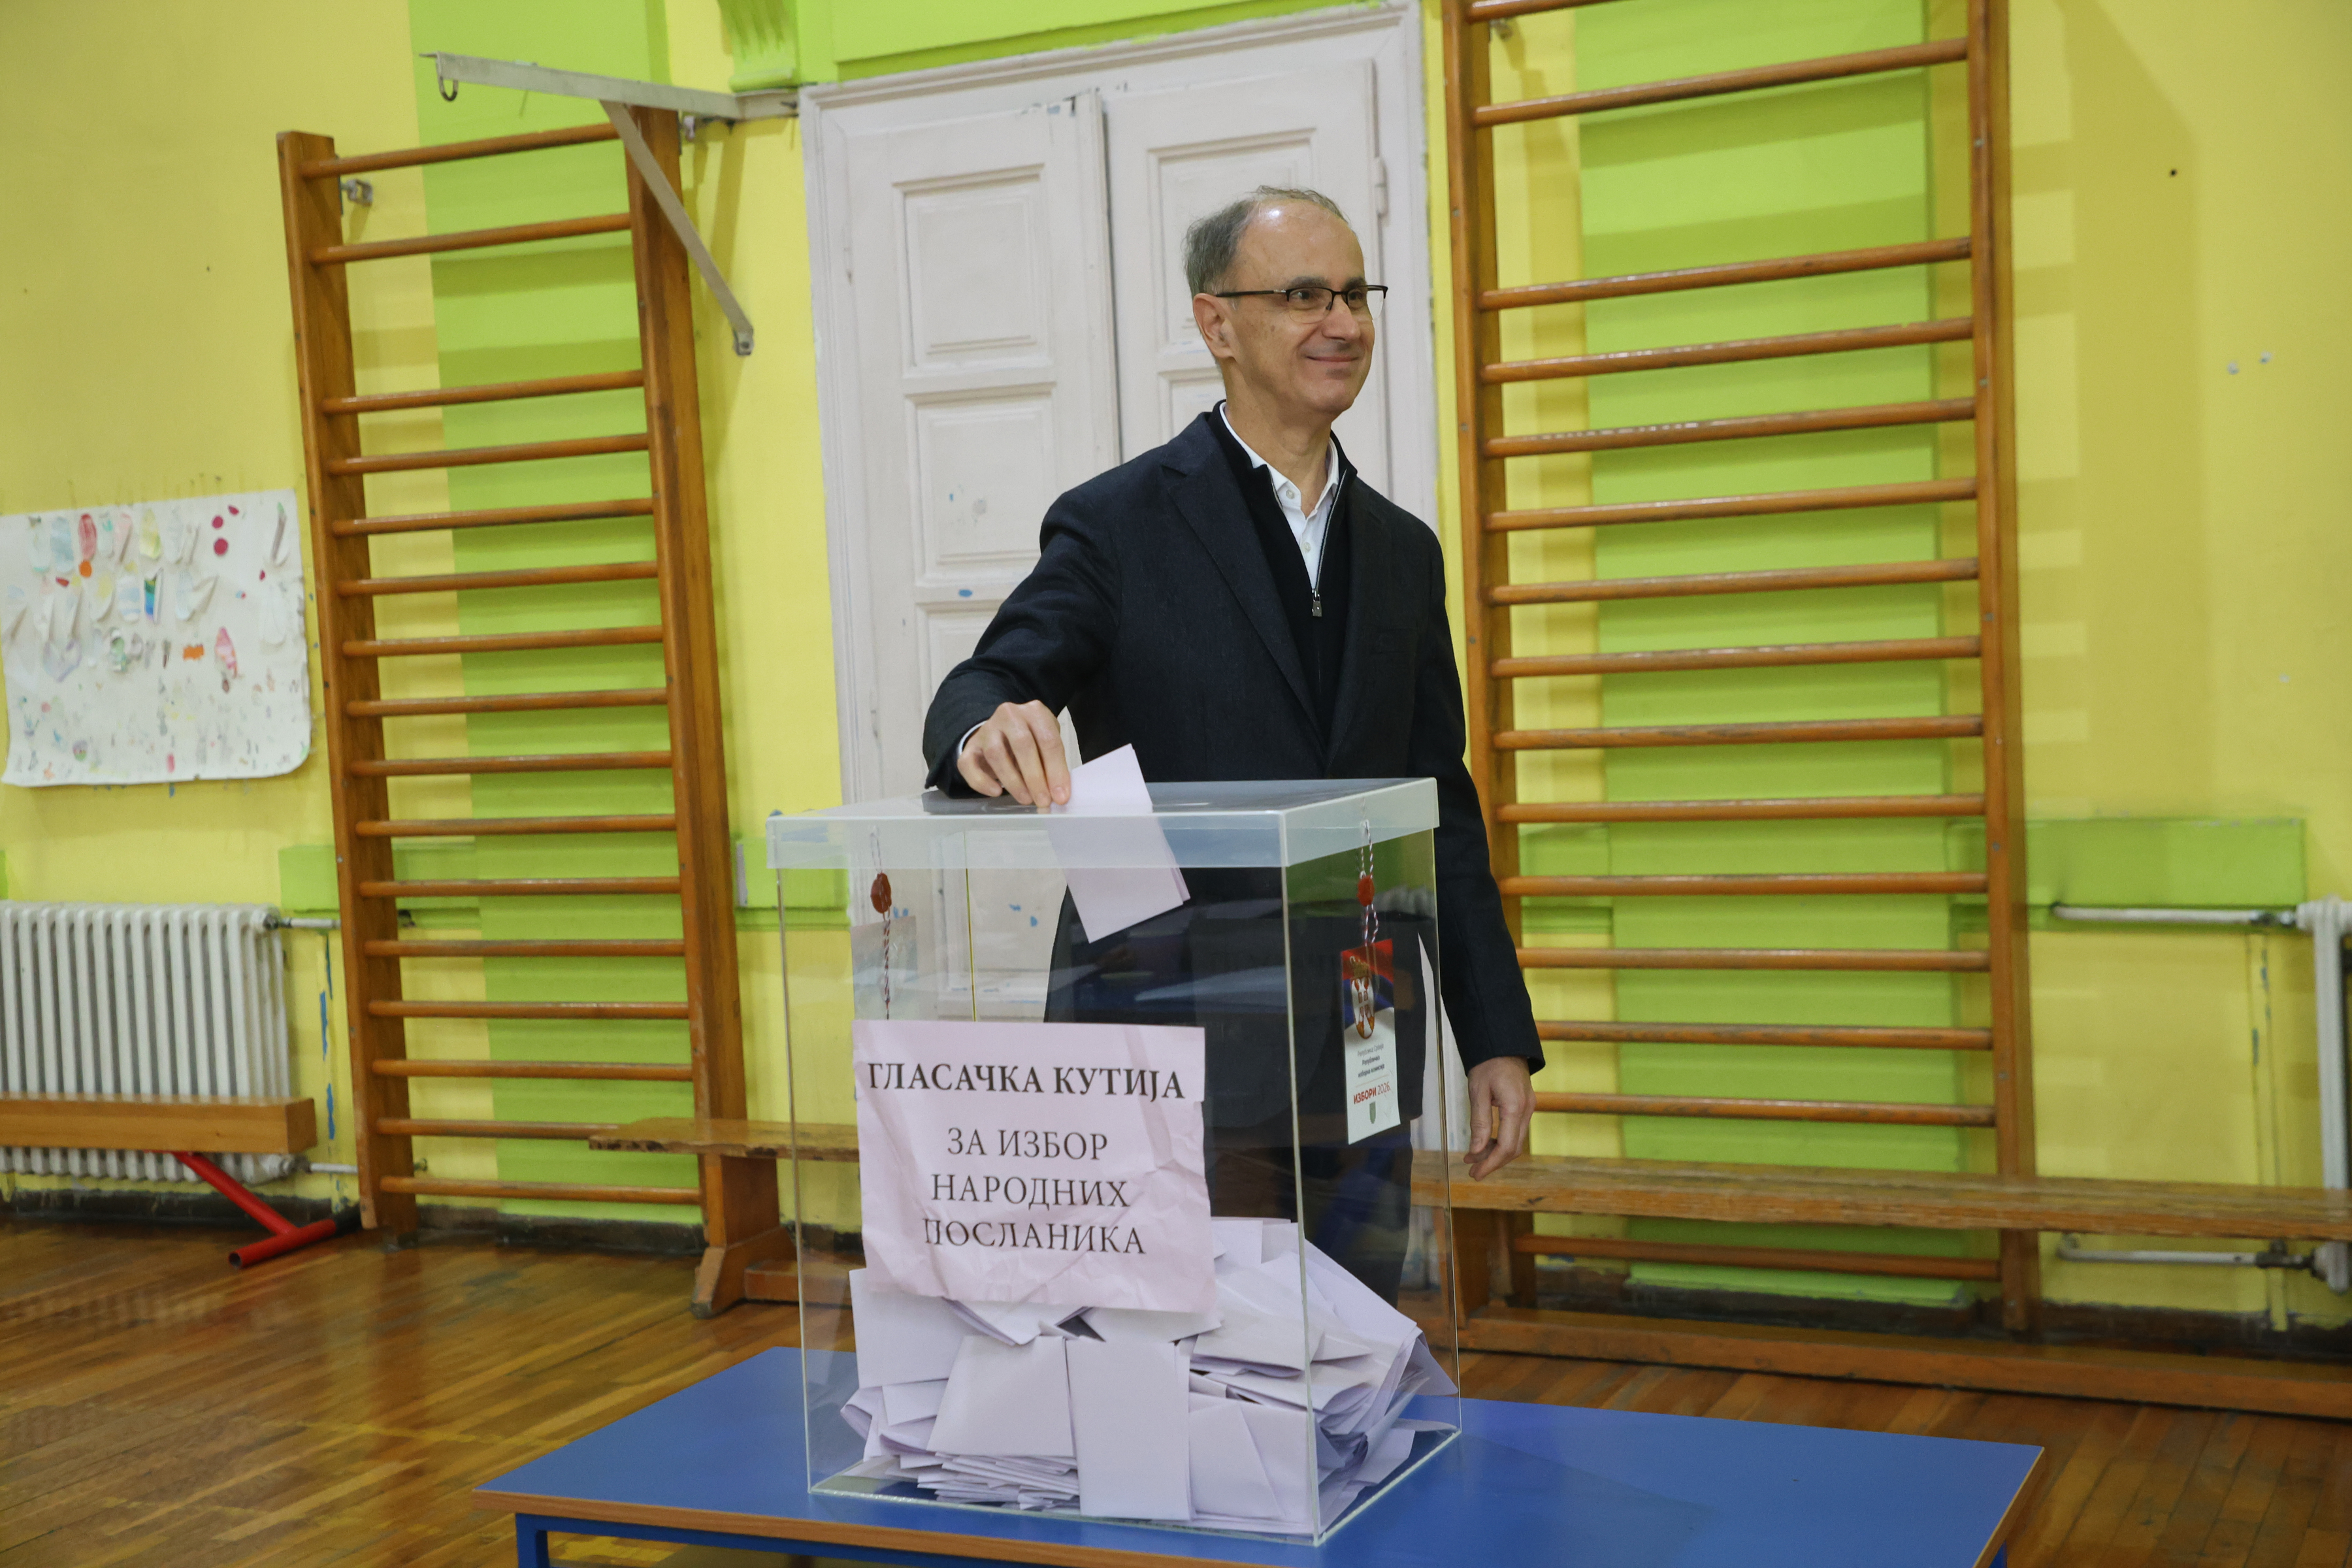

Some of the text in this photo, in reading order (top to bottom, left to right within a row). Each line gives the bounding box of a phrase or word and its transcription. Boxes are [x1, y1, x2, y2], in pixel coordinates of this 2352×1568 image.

[868, 1063, 1185, 1102] ГЛАСАЧКА КУТИЈА
[1354, 1086, 1377, 1104] ИЗБОРИ
[947, 1128, 1108, 1160] ЗА ИЗБОР
[931, 1174, 1131, 1210] НАРОДНИХ
[923, 1218, 1146, 1254] ПОСЛАНИКА
